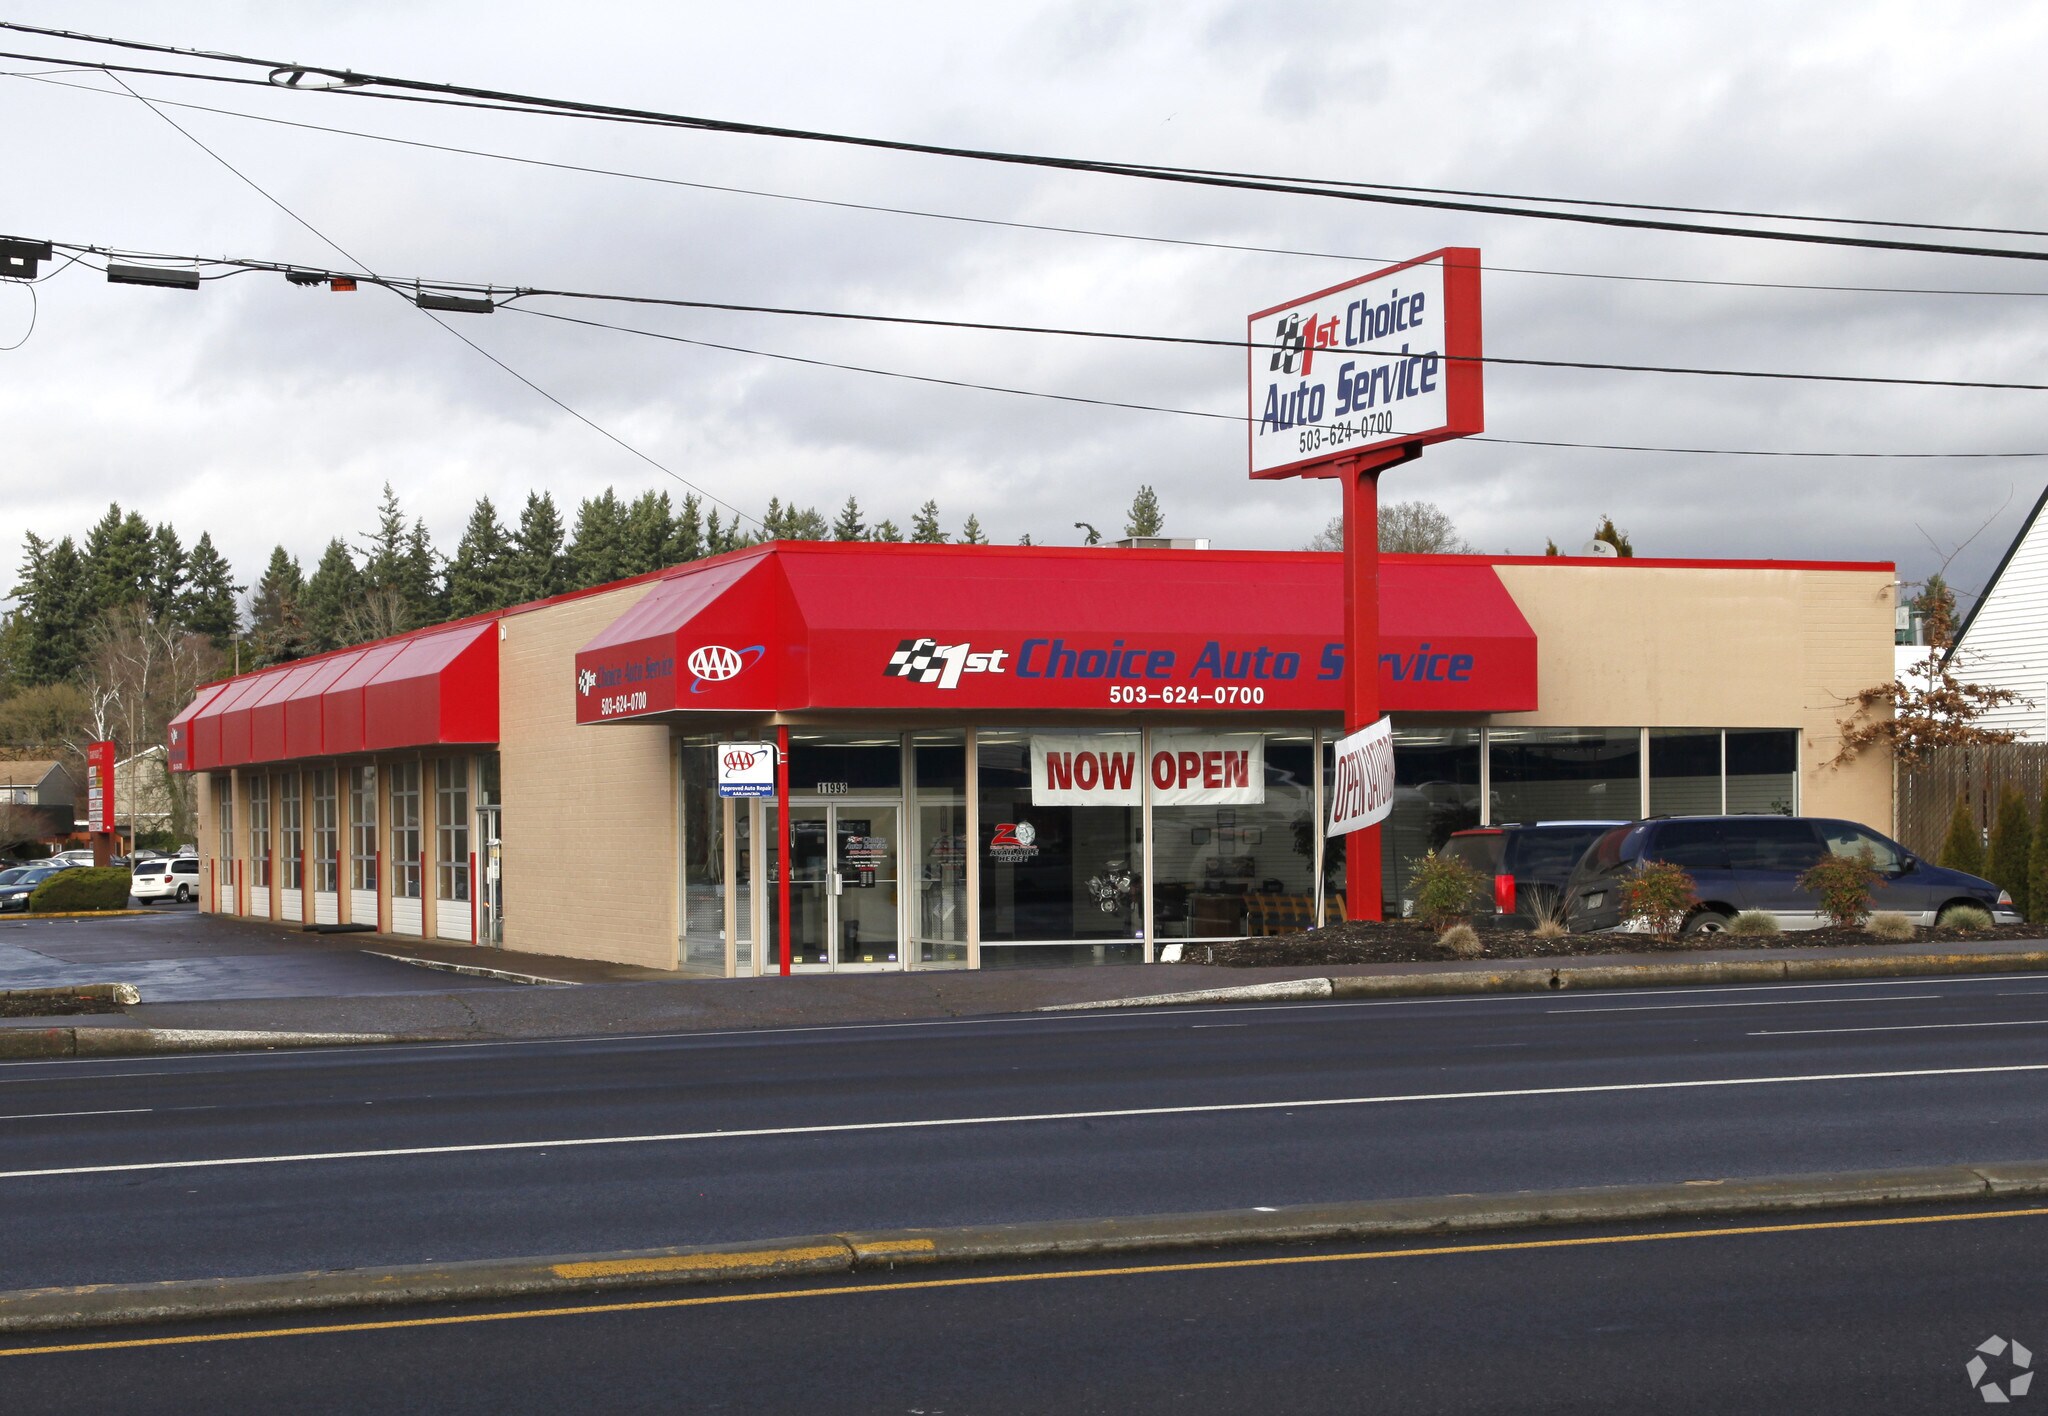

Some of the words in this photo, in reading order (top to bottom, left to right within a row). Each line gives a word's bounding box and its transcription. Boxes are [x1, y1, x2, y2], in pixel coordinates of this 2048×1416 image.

[1301, 313, 1341, 377] 1st
[1345, 288, 1425, 347] Choice
[1260, 381, 1325, 436] Auto
[1335, 343, 1438, 417] Service
[1299, 410, 1393, 454] 503-624-0700
[694, 646, 738, 681] AAA
[937, 641, 1009, 689] 1st
[1015, 638, 1175, 680] Choice
[1191, 640, 1301, 681] Auto
[1317, 642, 1474, 682] Srvice
[601, 691, 647, 715] 503-624-0700
[1109, 686, 1264, 704] 503-624-0700
[727, 750, 752, 770] AAA
[1046, 751, 1136, 790] NOW
[1151, 750, 1250, 790] OPEN
[817, 783, 848, 794] 11993
[1334, 749, 1365, 823] OPEN
[990, 849, 1039, 857] AVAILABLE
